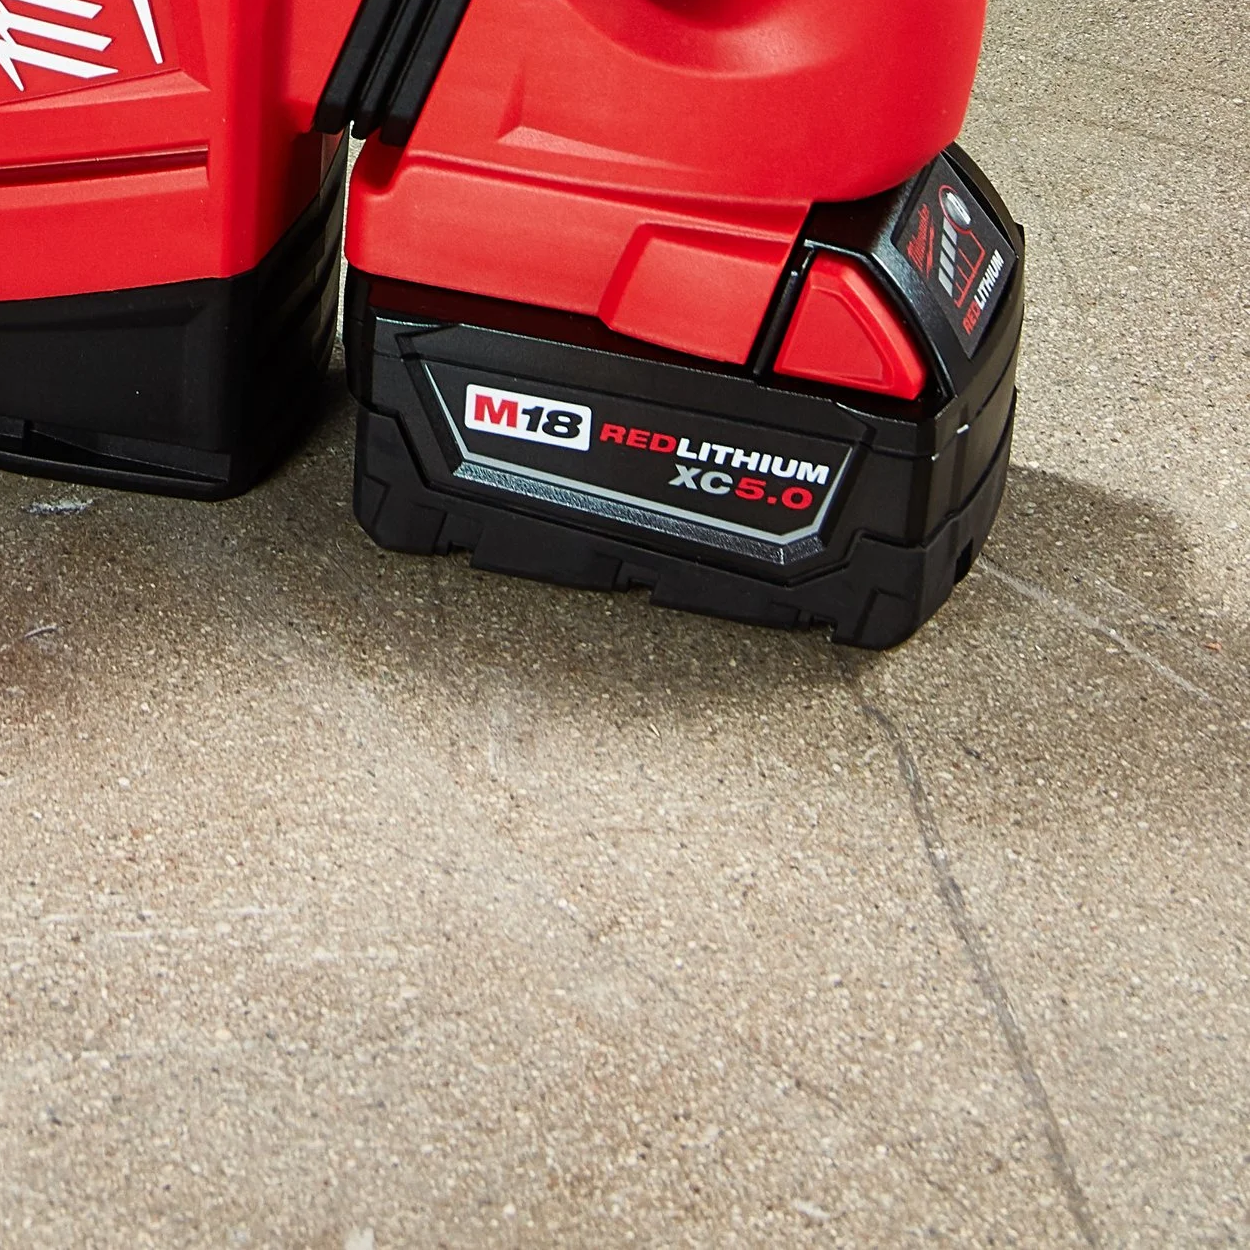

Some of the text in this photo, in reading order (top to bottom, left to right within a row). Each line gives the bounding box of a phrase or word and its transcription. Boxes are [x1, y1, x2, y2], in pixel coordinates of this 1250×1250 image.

[962, 248, 1005, 336] REDLITHIUM
[473, 393, 830, 485] M18 REDLITHIUM
[668, 464, 814, 510] XC5.0
